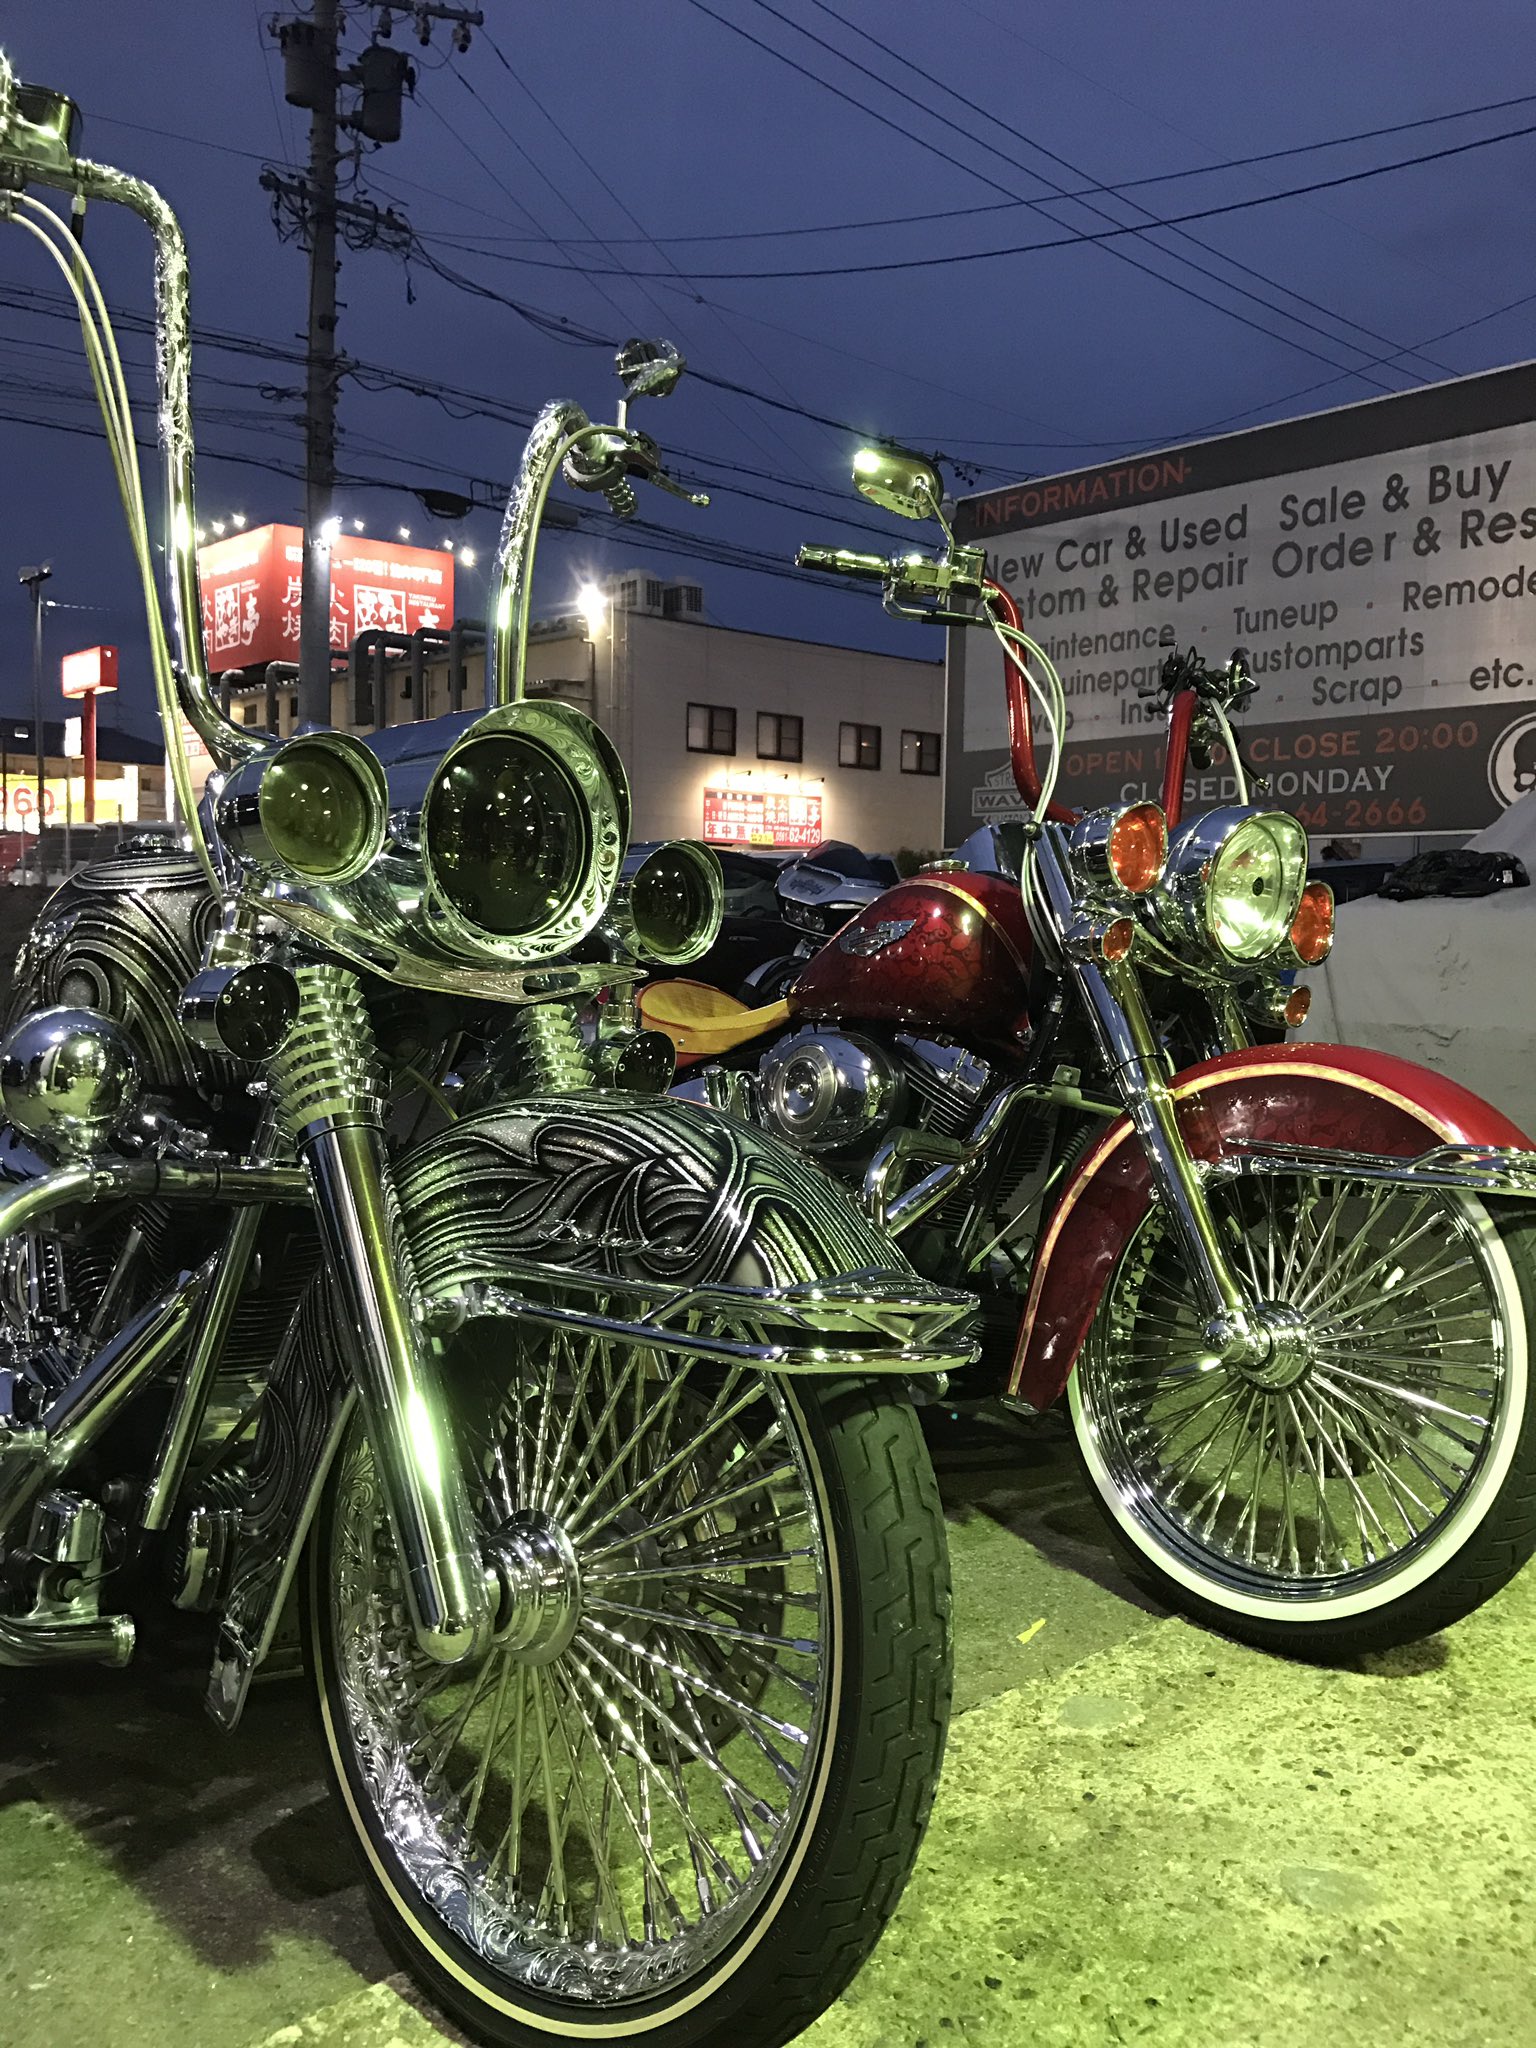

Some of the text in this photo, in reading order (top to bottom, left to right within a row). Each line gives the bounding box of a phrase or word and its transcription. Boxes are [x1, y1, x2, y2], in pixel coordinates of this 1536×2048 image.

[1279, 459, 1512, 532] Sale & Buy
[1056, 537, 1113, 573] Car
[1125, 525, 1147, 561] &
[1160, 503, 1249, 553] Used
[1271, 531, 1397, 579] Order
[1412, 516, 1442, 557] &
[1099, 573, 1119, 608] &
[1132, 551, 1249, 602] Repair
[1233, 600, 1338, 635] Tuneup
[1241, 627, 1424, 671] ustomparts
[1311, 674, 1403, 706] Scrap
[1469, 657, 1534, 691] etc.
[1066, 750, 1142, 776] OPEN
[1249, 730, 1361, 763] CLOSE
[1375, 720, 1479, 753] 20:00
[1251, 764, 1395, 799] MONDAY
[789, 827, 821, 844] 62-4129
